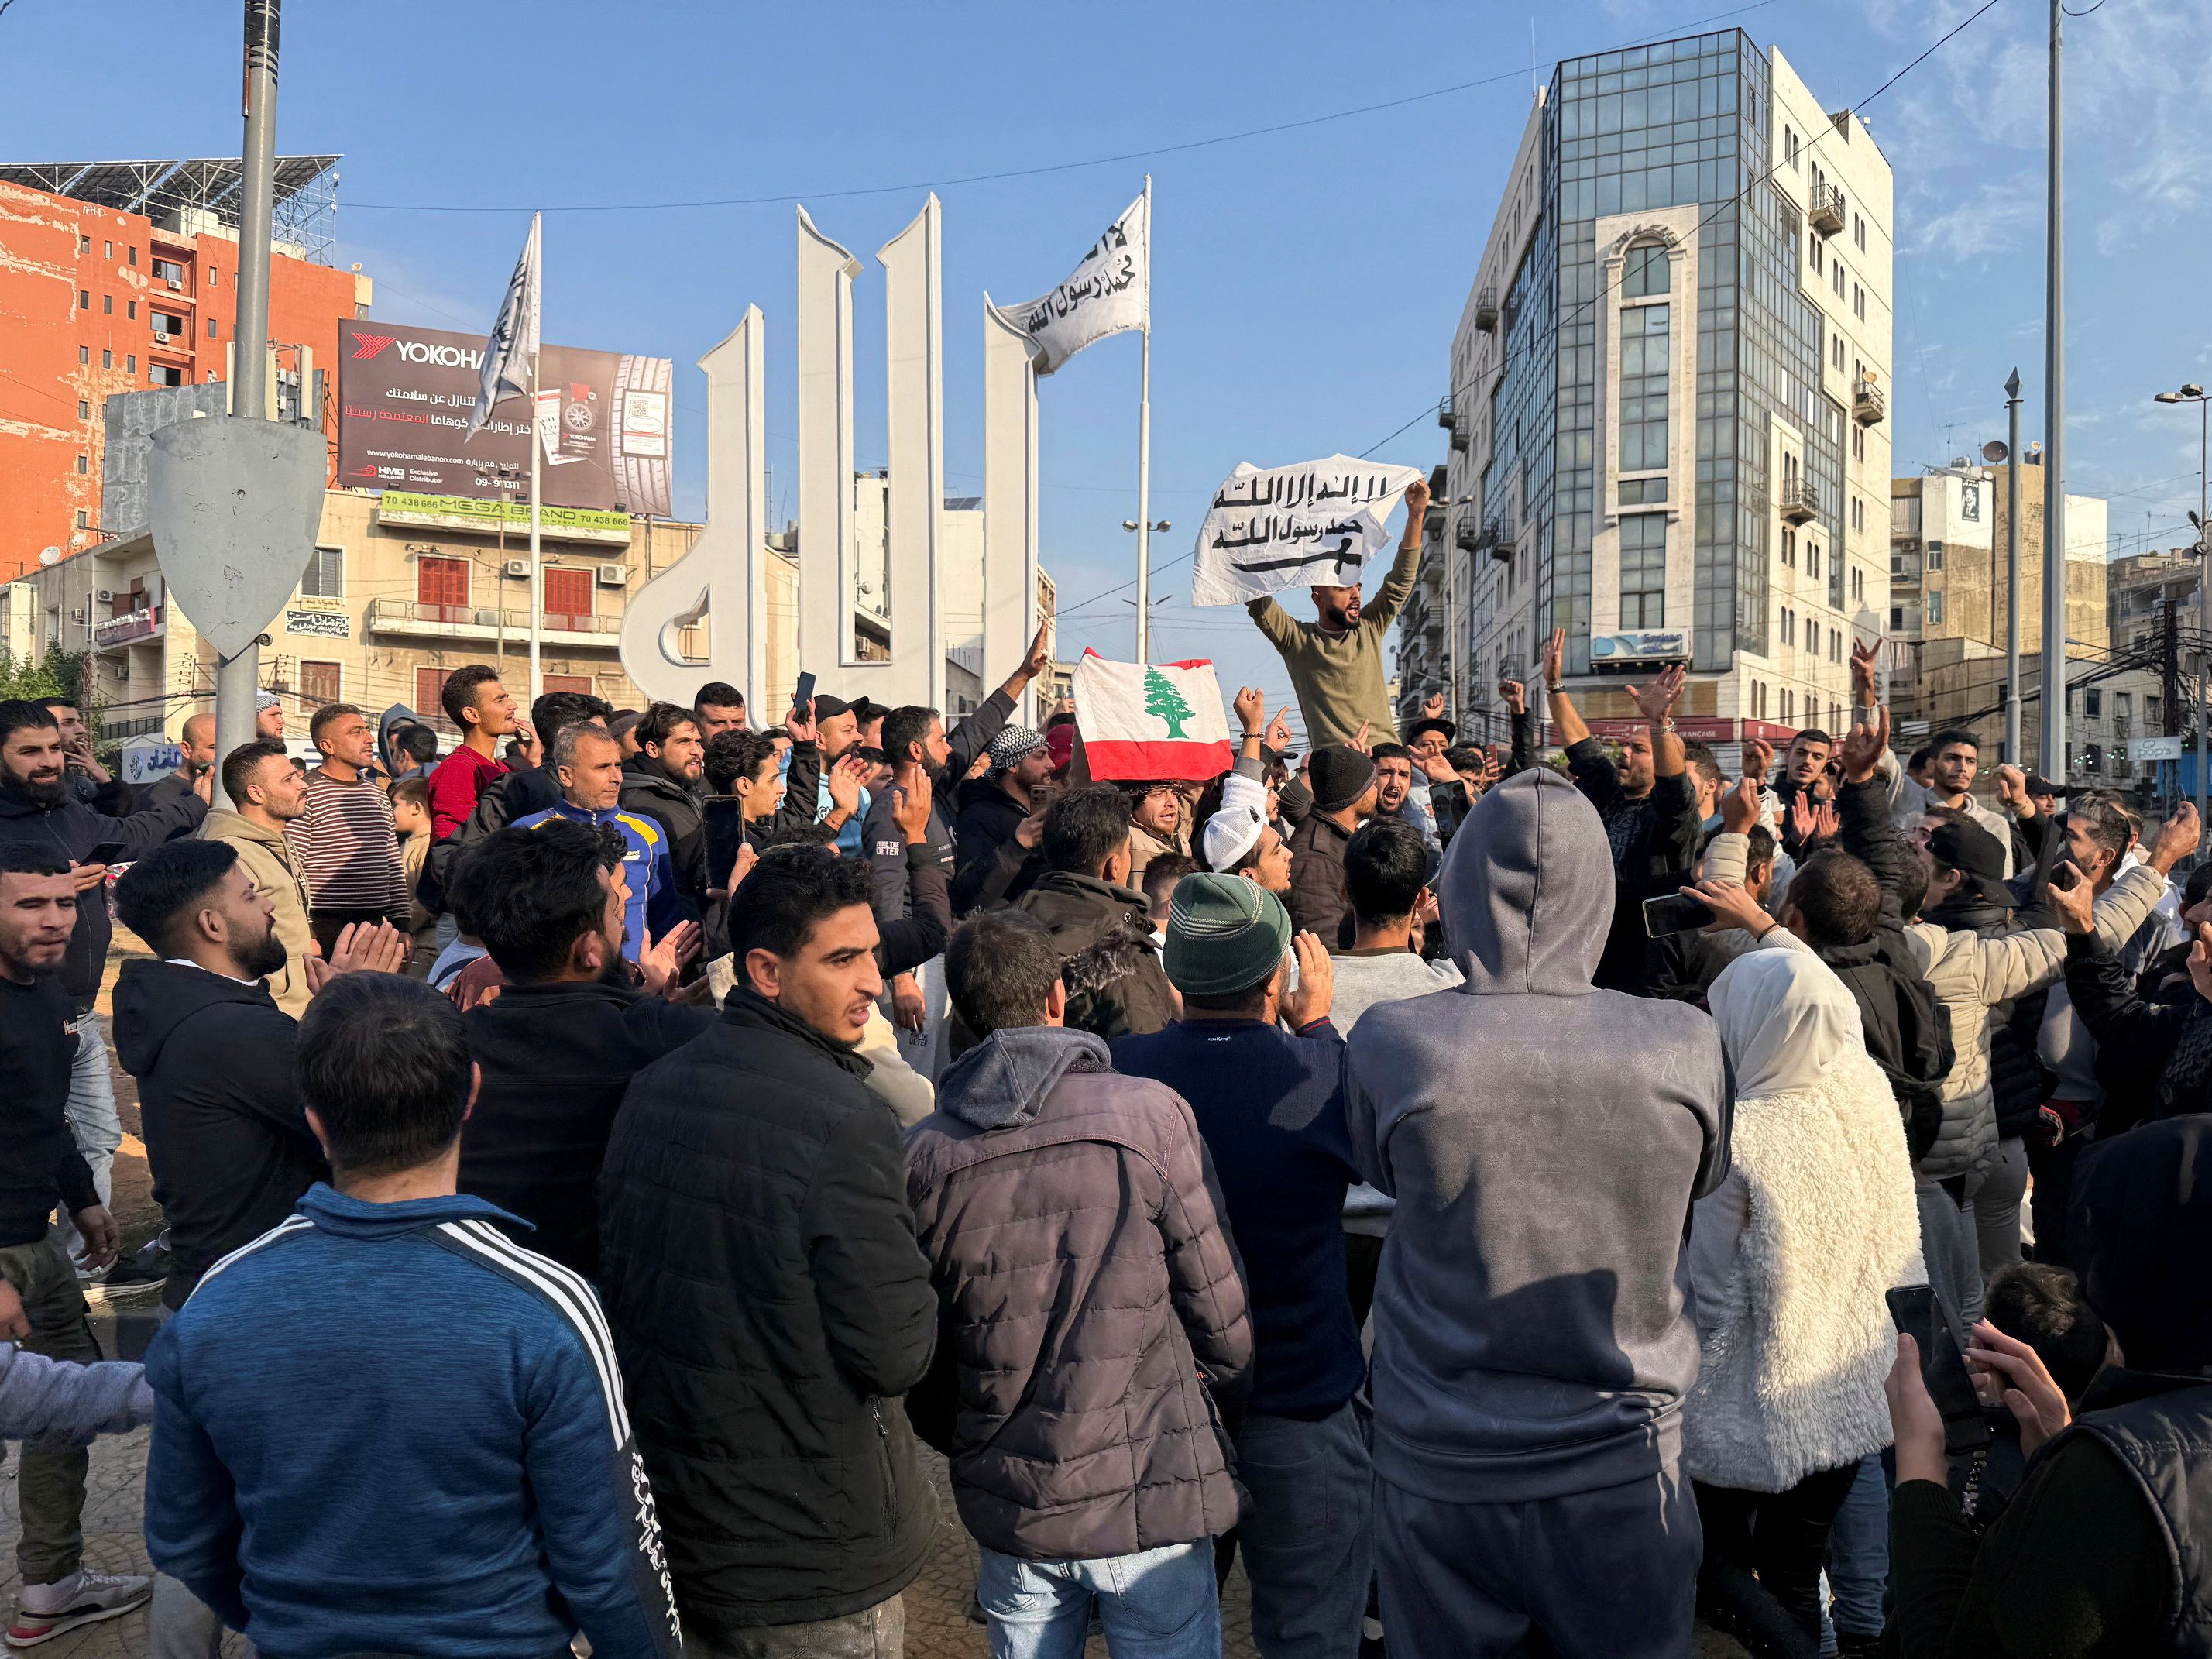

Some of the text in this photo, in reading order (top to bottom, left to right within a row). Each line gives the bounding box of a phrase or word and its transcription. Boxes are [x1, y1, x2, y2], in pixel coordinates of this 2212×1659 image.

[386, 387, 428, 401] سلامتك
[430, 393, 445, 404] عن
[379, 410, 428, 424] المعتمدة
[431, 414, 469, 430] كوهاما
[514, 424, 531, 436] ختر
[366, 449, 464, 465] www.yokohamalebanon.com
[378, 465, 405, 476] HMG
[409, 468, 438, 477] Exclusive
[409, 475, 443, 484] Distributor
[493, 479, 520, 489] 91311
[386, 496, 398, 505] 70
[401, 498, 419, 507] 438
[421, 500, 438, 509] 666
[581, 514, 592, 524] 70
[593, 516, 610, 524] 438
[612, 517, 629, 526] 666
[1211, 514, 1279, 549] الله
[1279, 514, 1324, 544] رسول
[876, 847, 899, 856] DETER
